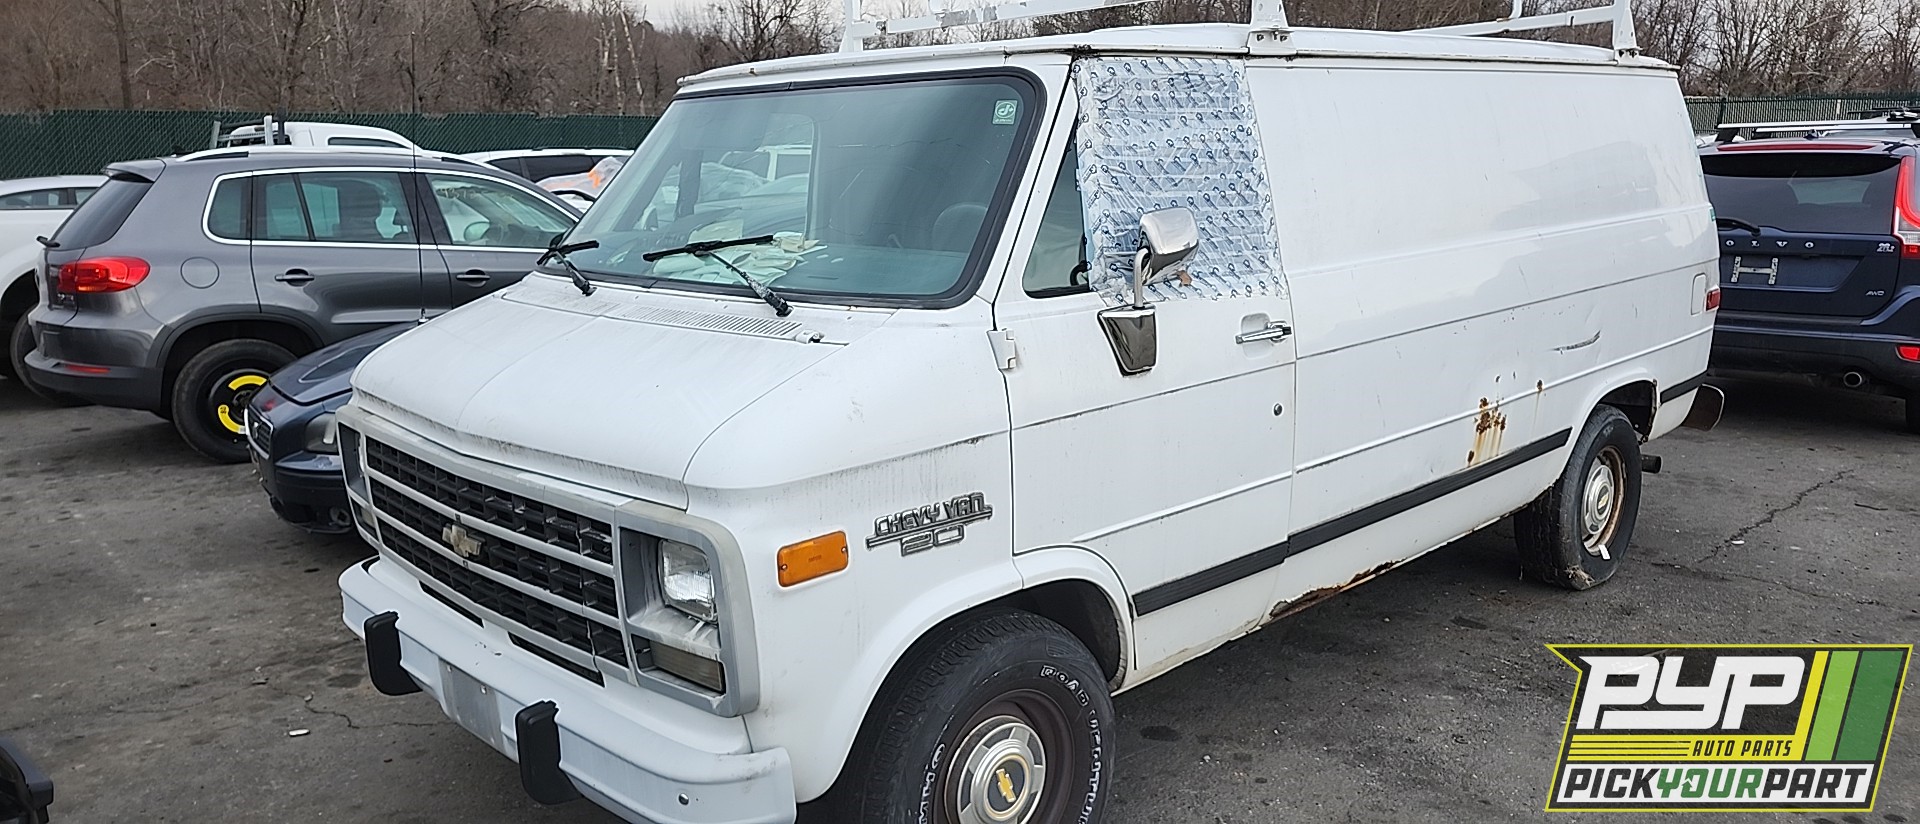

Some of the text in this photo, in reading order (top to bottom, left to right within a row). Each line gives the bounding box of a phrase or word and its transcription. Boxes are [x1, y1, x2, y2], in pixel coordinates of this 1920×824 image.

[874, 492, 986, 537] CHEVY VAN
[901, 523, 965, 557] 20
[1040, 664, 1090, 707] ROAD
